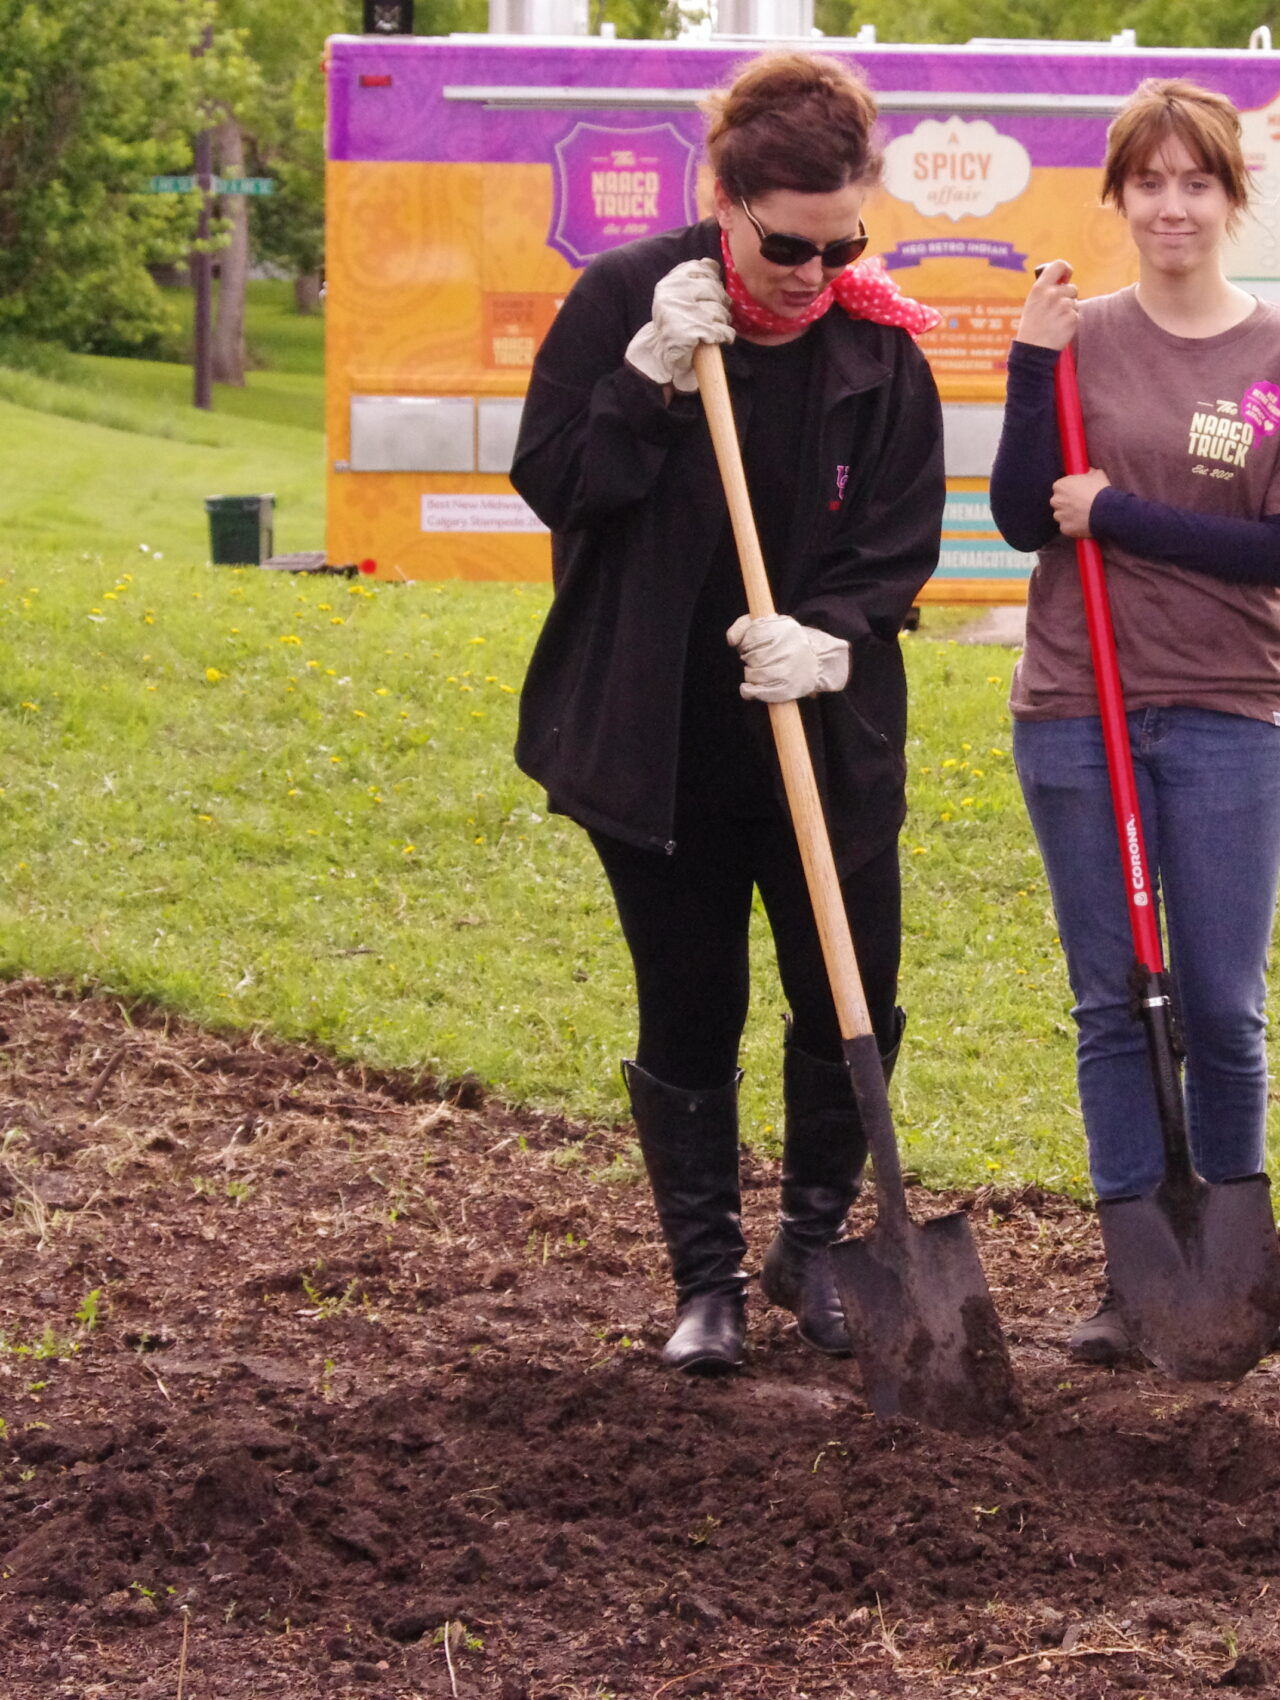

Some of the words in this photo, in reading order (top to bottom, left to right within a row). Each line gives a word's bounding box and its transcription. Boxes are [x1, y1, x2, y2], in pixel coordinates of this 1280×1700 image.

[947, 132, 960, 145] A
[913, 152, 992, 181] SPICY
[591, 171, 660, 193] NAACO
[592, 193, 659, 218] TRUCK
[926, 185, 982, 206] affair
[901, 243, 926, 256] NEO
[928, 241, 966, 254] RETRO
[967, 242, 1009, 256] INDIAN
[1216, 399, 1238, 416] The
[1190, 411, 1254, 446] NAACO
[1188, 432, 1249, 468] TRUCK
[1209, 468, 1234, 480] 2012
[452, 499, 478, 510] New
[480, 499, 523, 512] Midway
[426, 515, 469, 529] Calgary
[470, 515, 525, 528] Stampede
[1126, 817, 1144, 889] CORONA
